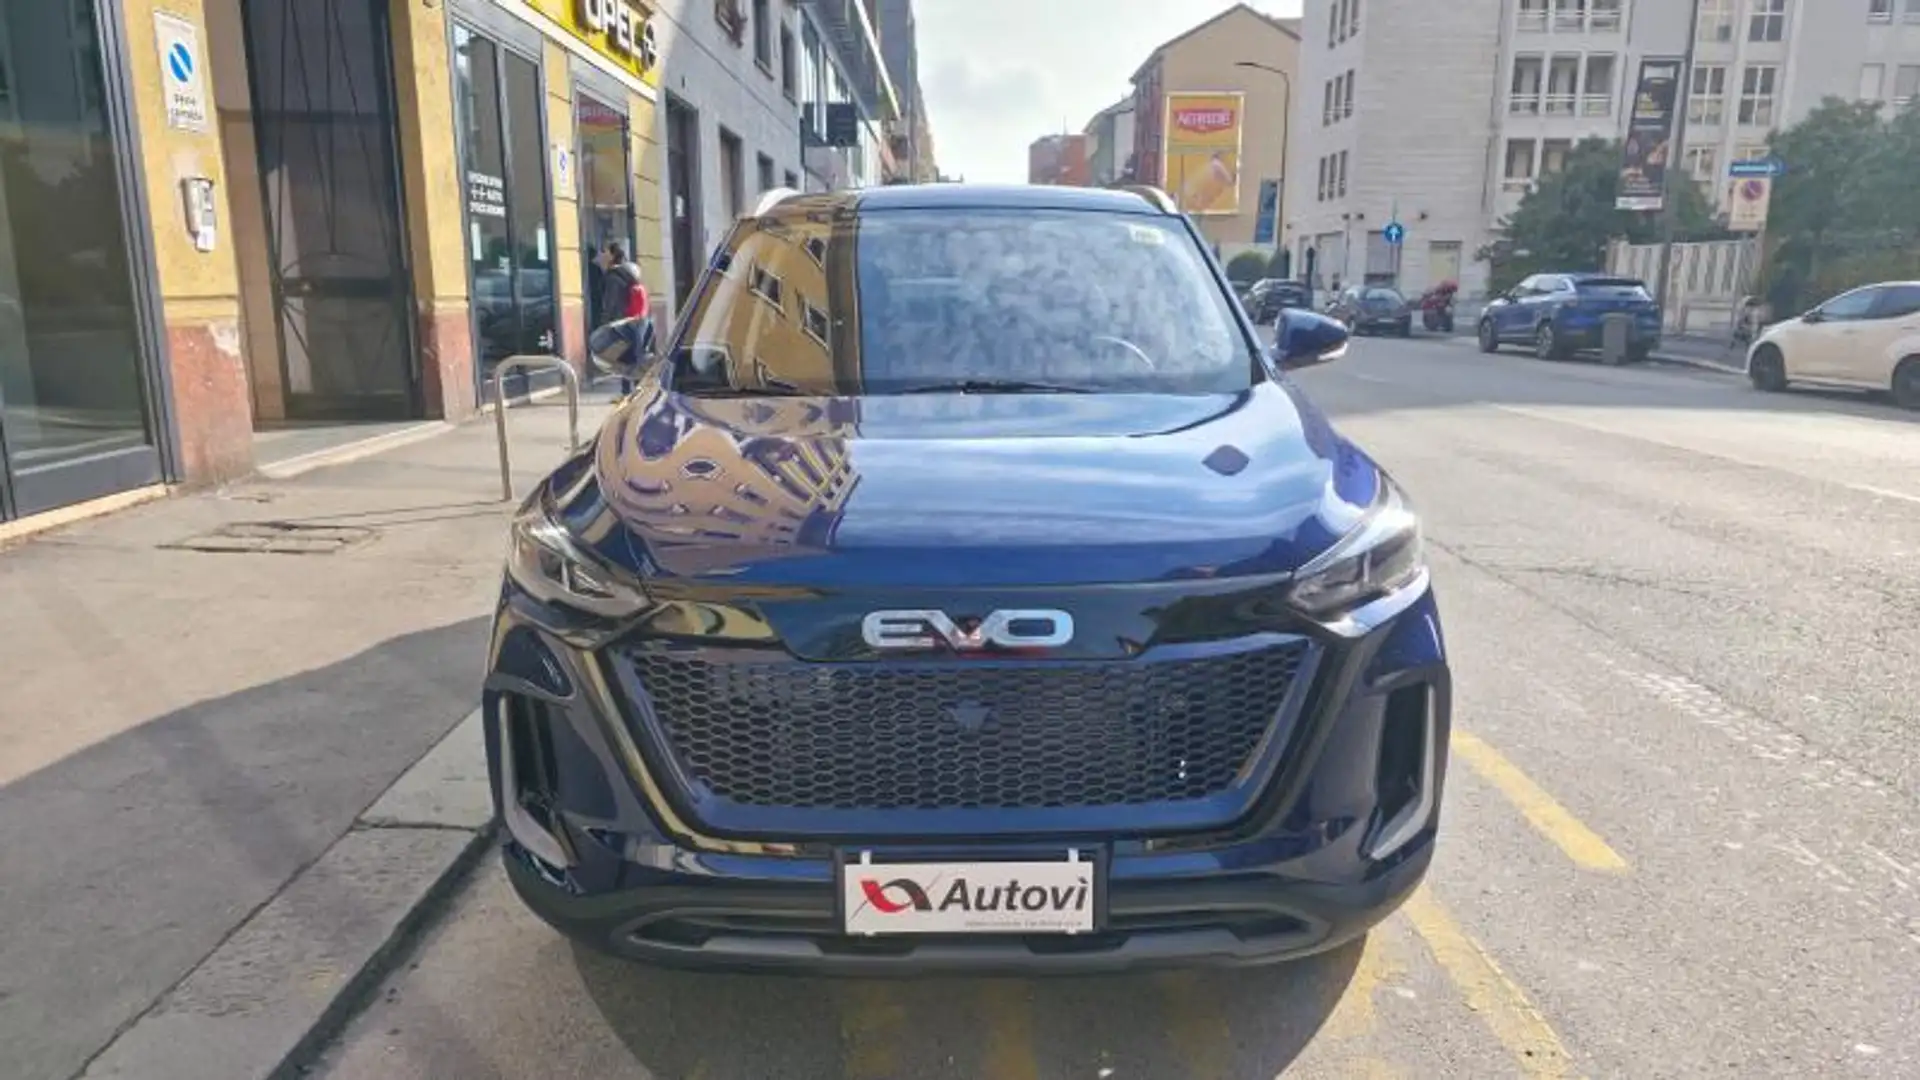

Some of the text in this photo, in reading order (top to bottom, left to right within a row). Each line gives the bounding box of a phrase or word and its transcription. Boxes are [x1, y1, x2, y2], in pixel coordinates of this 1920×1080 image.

[583, 0, 643, 58] OPEL
[861, 609, 1074, 648] EVO
[938, 876, 1089, 912] Autovì
